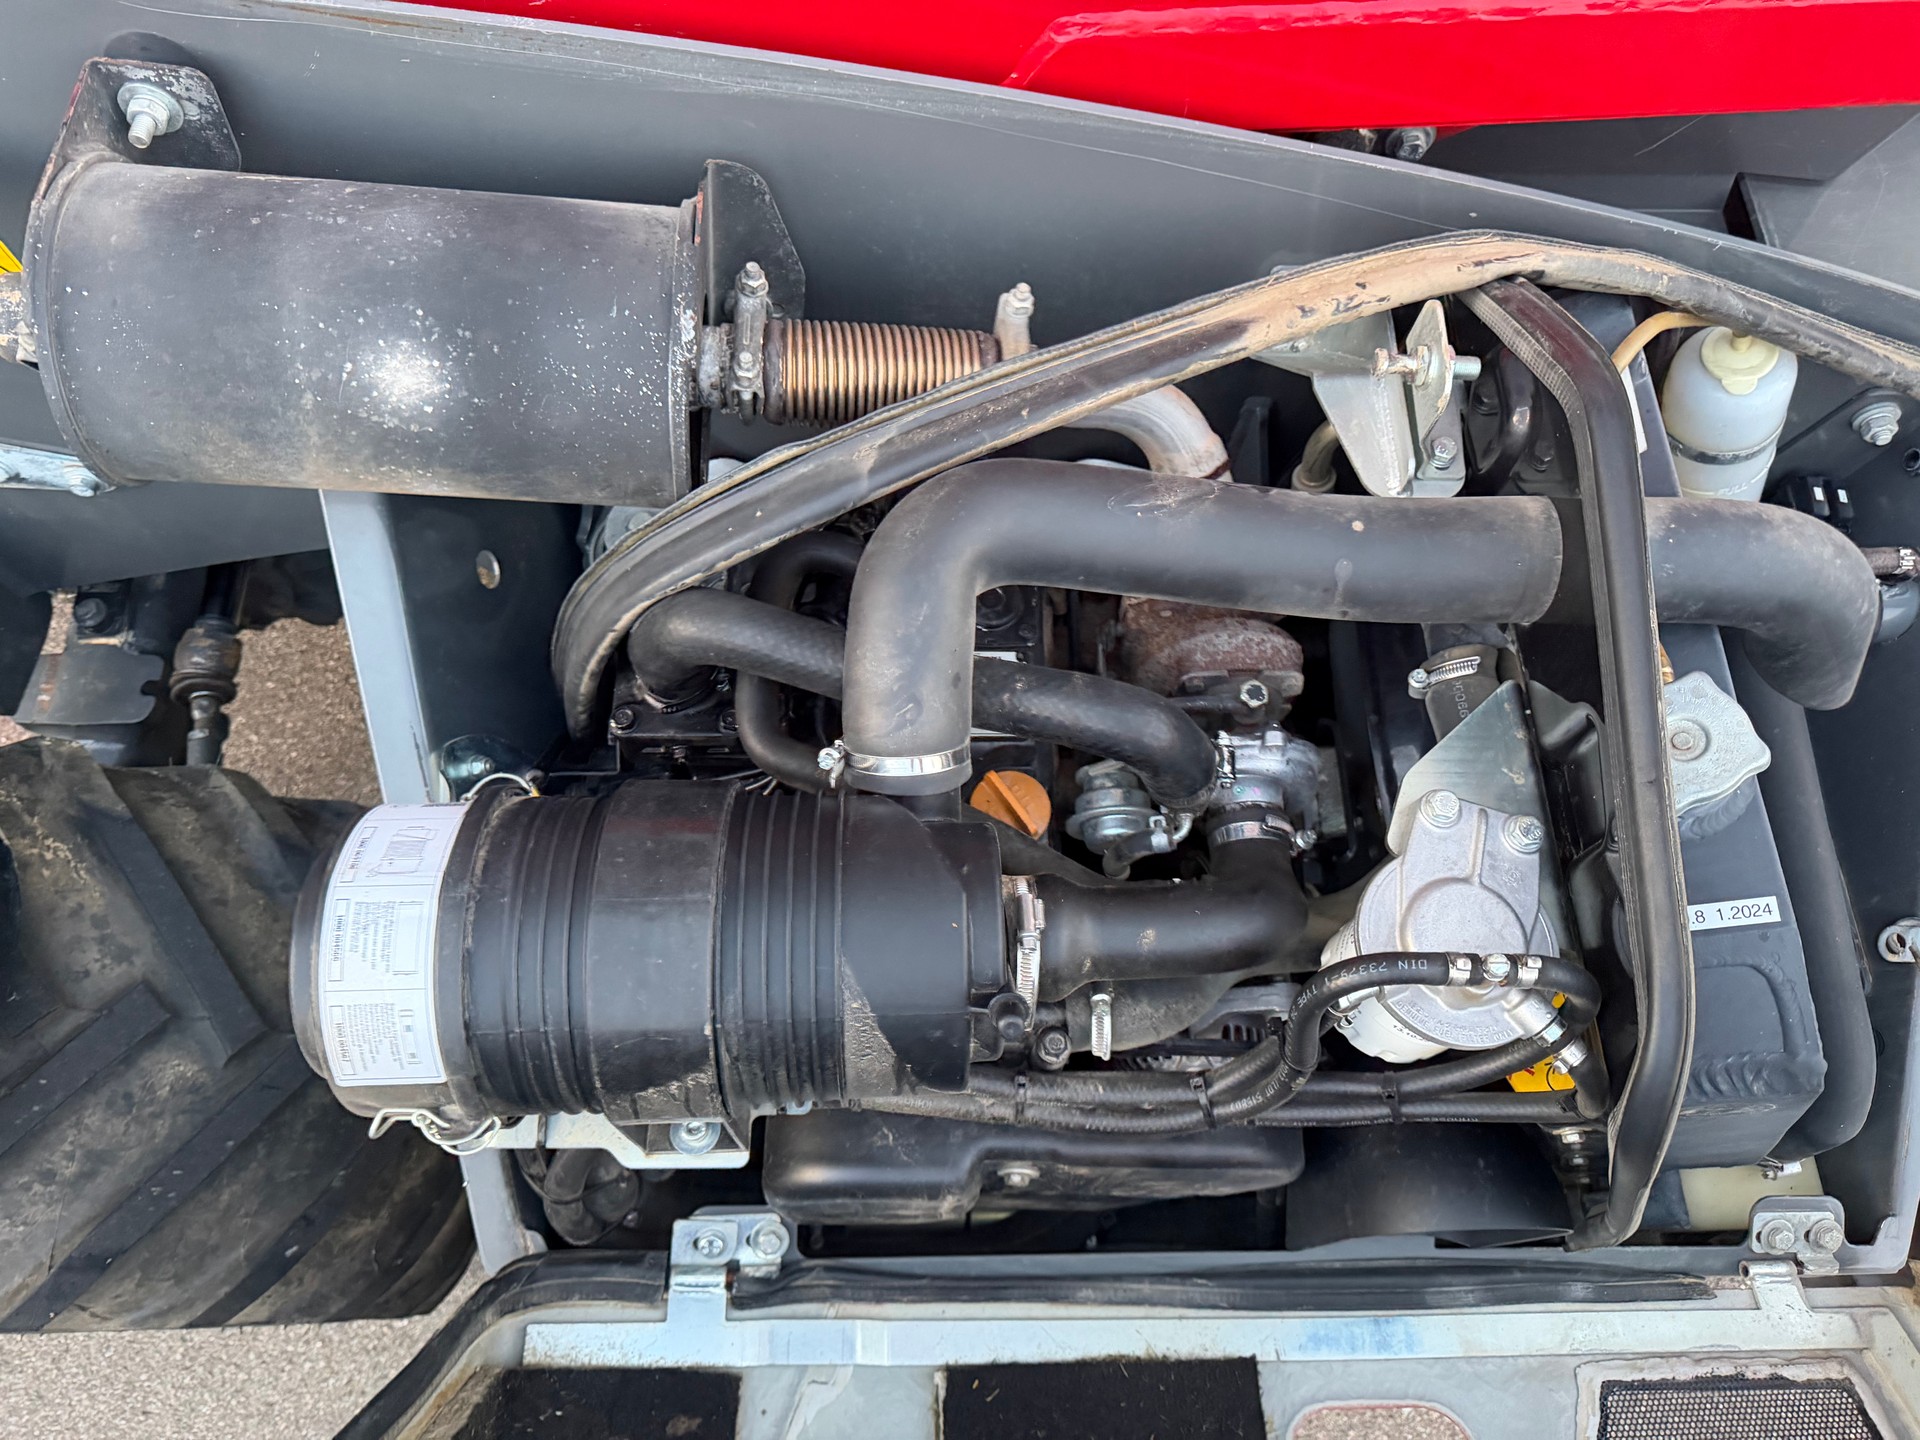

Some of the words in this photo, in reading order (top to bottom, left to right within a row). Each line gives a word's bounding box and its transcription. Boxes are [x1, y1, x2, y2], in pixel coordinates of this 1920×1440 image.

[1715, 902, 1773, 921] 1.2024
[1324, 960, 1387, 984] 73379-1
[1398, 959, 1427, 970] DIN
[1296, 983, 1318, 1005] TYPE
